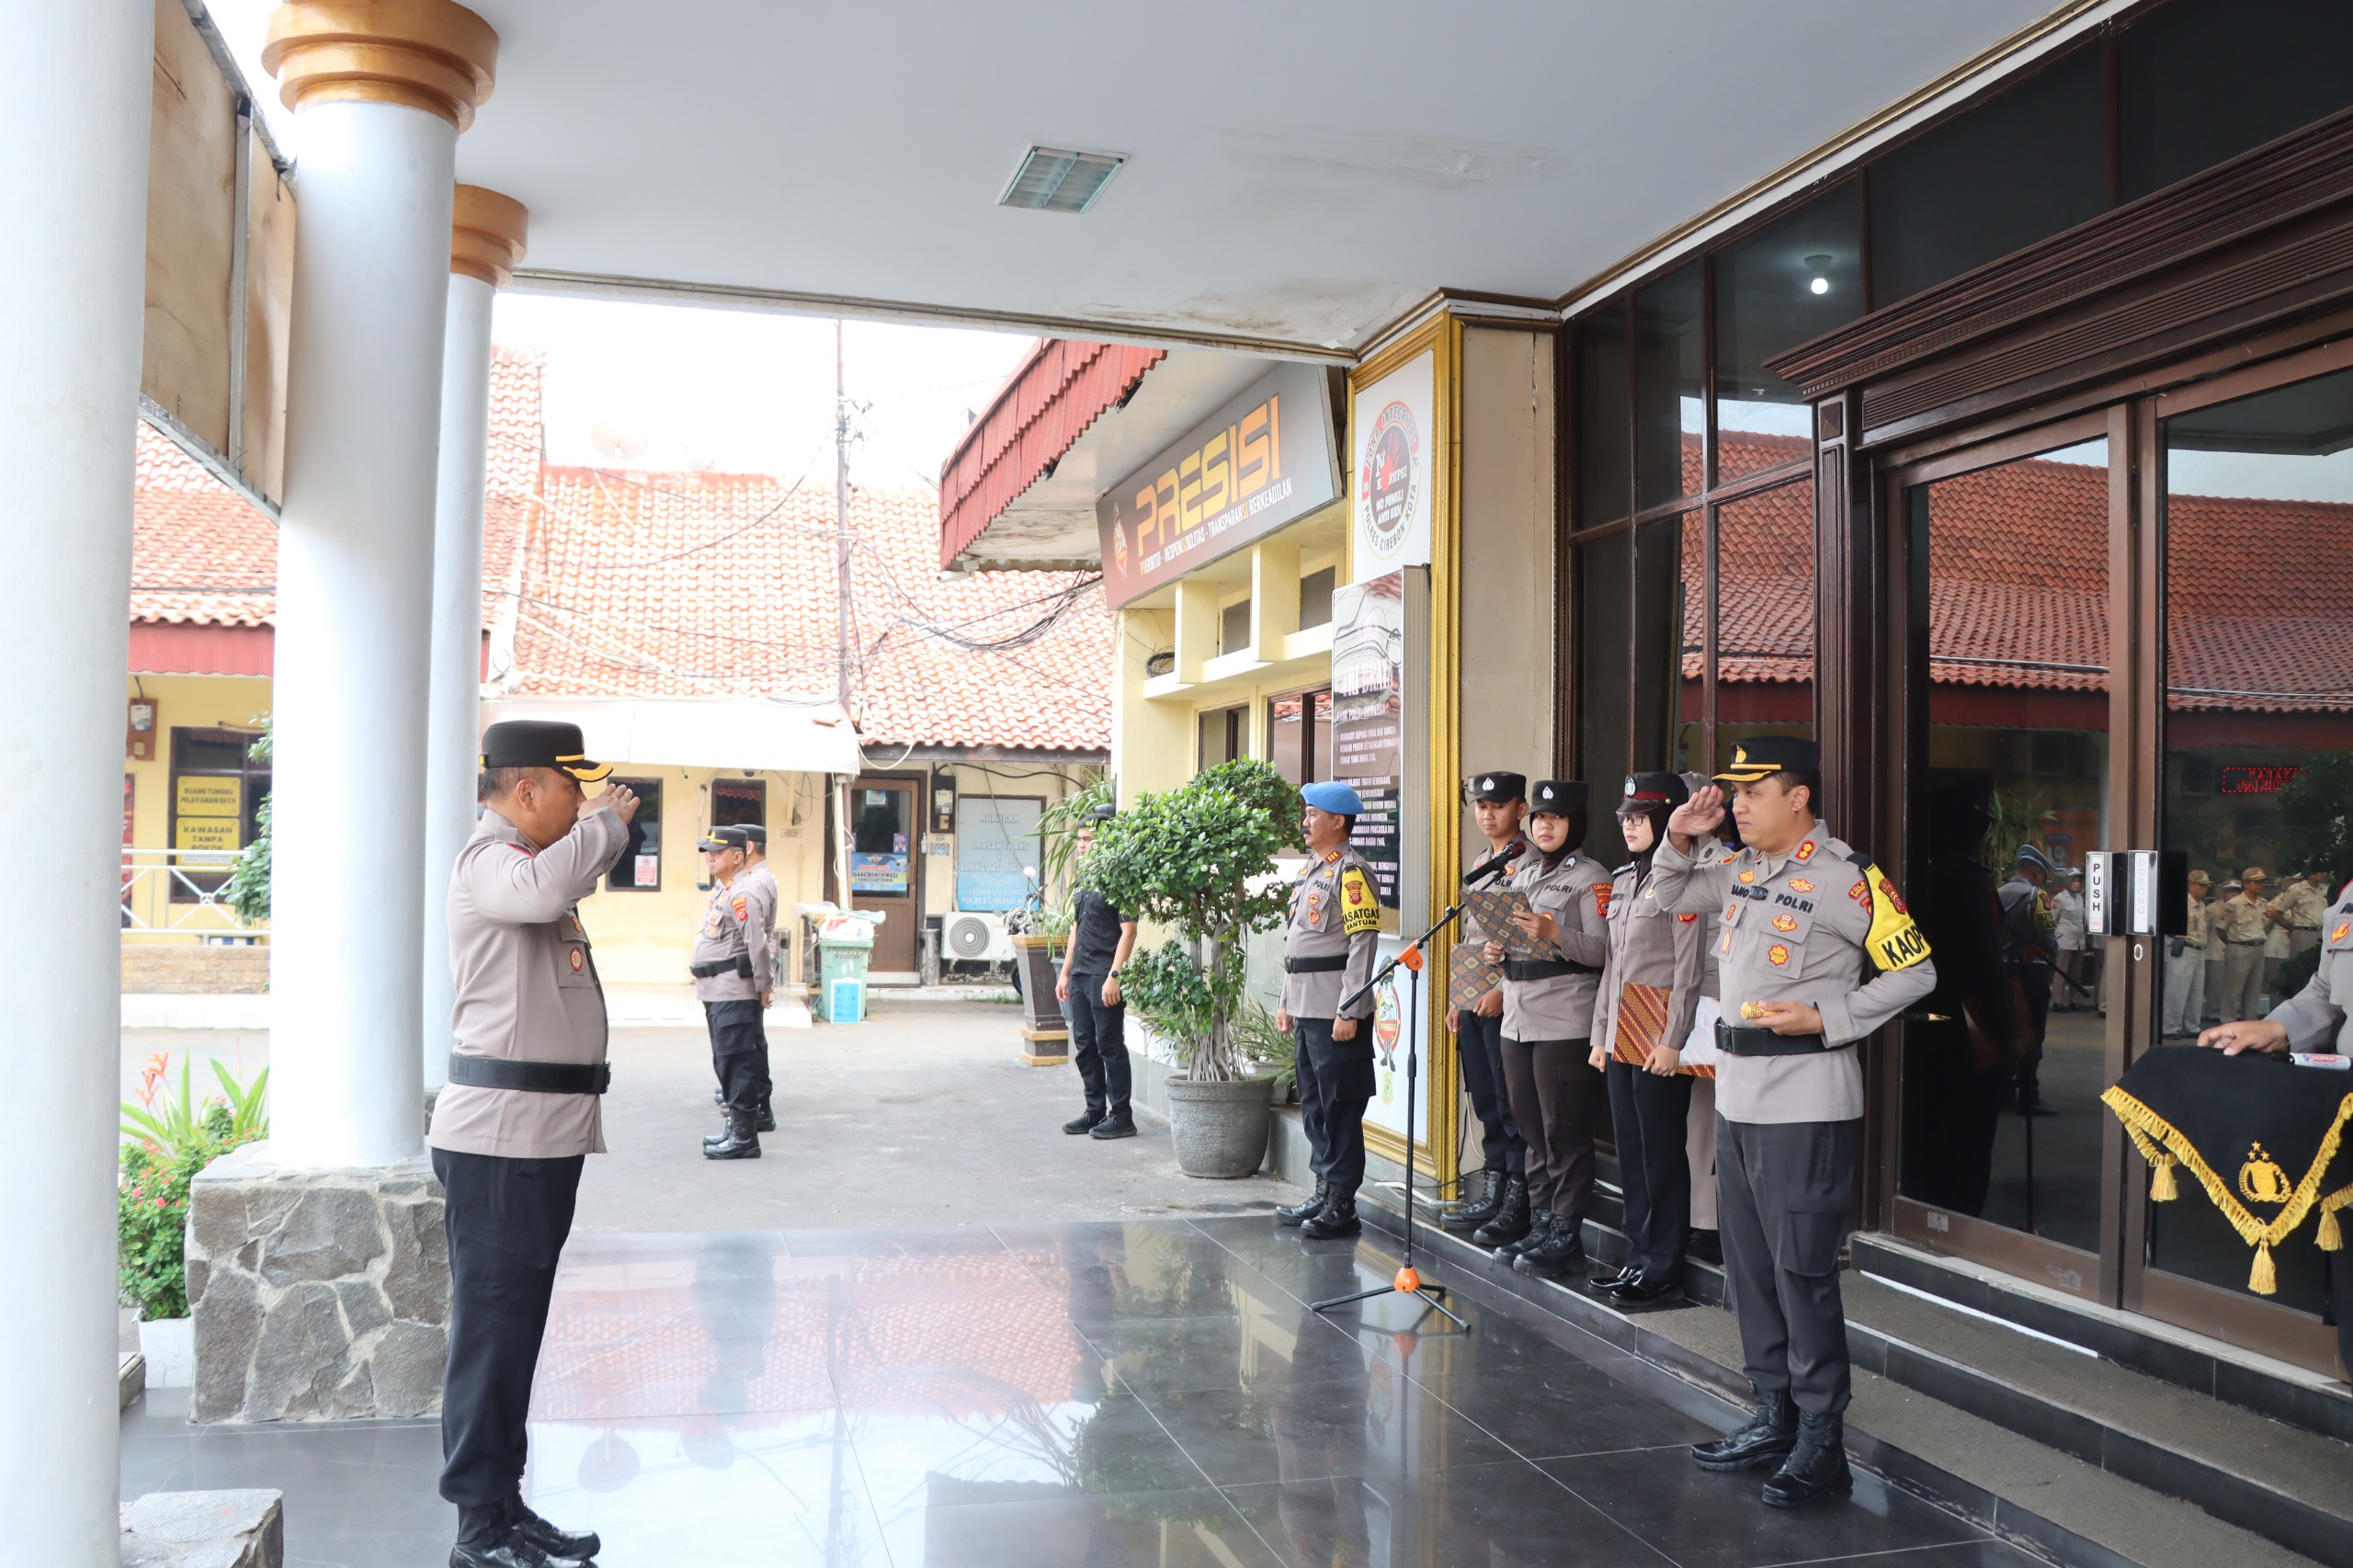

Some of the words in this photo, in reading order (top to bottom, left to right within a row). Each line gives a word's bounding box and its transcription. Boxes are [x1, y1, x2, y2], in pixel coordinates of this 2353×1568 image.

[1365, 427, 1380, 468] ZONA
[1382, 404, 1416, 446] INTEGRITAS
[1136, 393, 1279, 558] PRESISI
[1165, 526, 1205, 562] RESPONSIBILITAS
[1208, 501, 1249, 539] TRANSPARANSI
[1249, 477, 1292, 516] BERKEADILAN
[1365, 504, 1379, 546] POLRES
[1380, 522, 1405, 551] CIREBON
[1405, 484, 1416, 520] KOTA
[1376, 497, 1384, 512] NO
[980, 813, 1019, 824] RUANGAN
[1313, 880, 1330, 892] POLRI
[1544, 883, 1573, 893] POLRI
[1775, 893, 1813, 913] POLRI
[2093, 863, 2101, 912] PUSH
[2137, 858, 2146, 915] DORONG
[1347, 919, 1377, 930] BANTUAN
